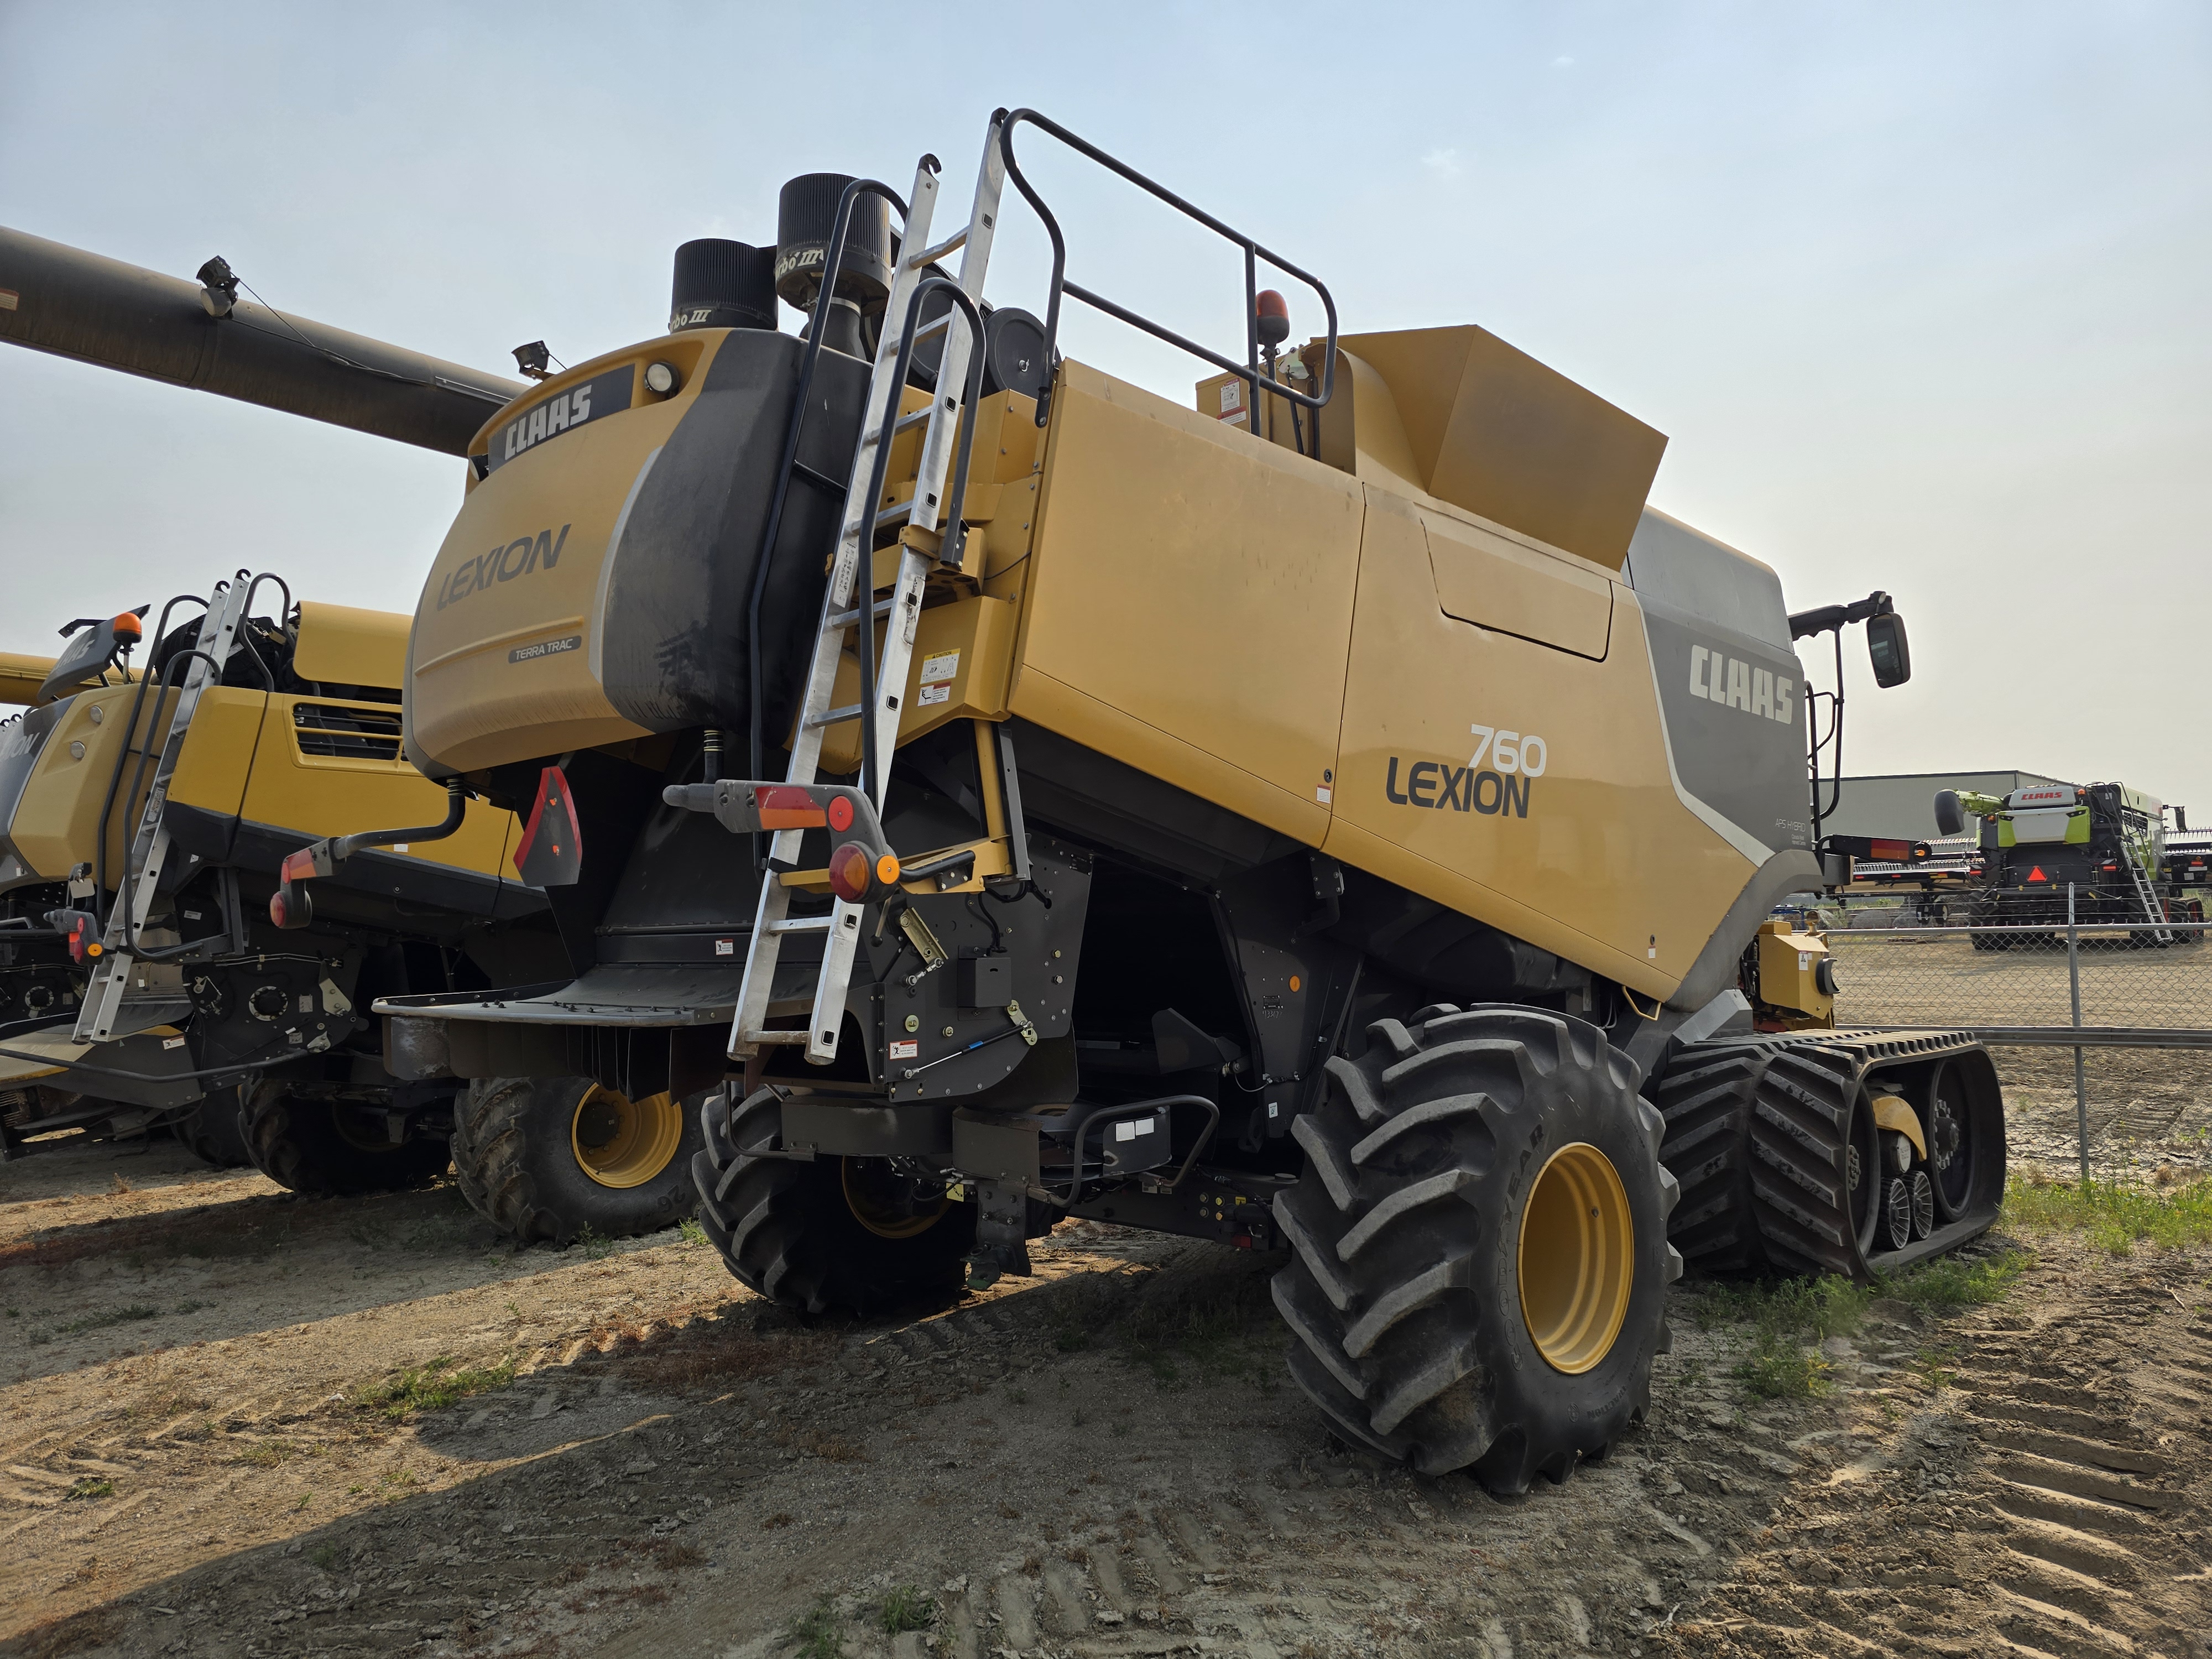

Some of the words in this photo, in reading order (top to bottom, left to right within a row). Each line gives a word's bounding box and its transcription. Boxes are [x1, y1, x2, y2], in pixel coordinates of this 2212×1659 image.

[688, 310, 712, 324] III
[504, 384, 592, 461] CLAAS
[437, 523, 572, 612] LEXION
[516, 645, 545, 660] TERRA
[547, 638, 573, 653] TRAC
[1689, 644, 1793, 724] CLAAS
[1468, 723, 1547, 778] 760
[1386, 757, 1531, 818] LEXION
[2021, 792, 2063, 800] CLAAS
[1775, 818, 1786, 828] APS
[1787, 821, 1806, 832] HYBRID
[1496, 1124, 1545, 1371] GOODYEAR
